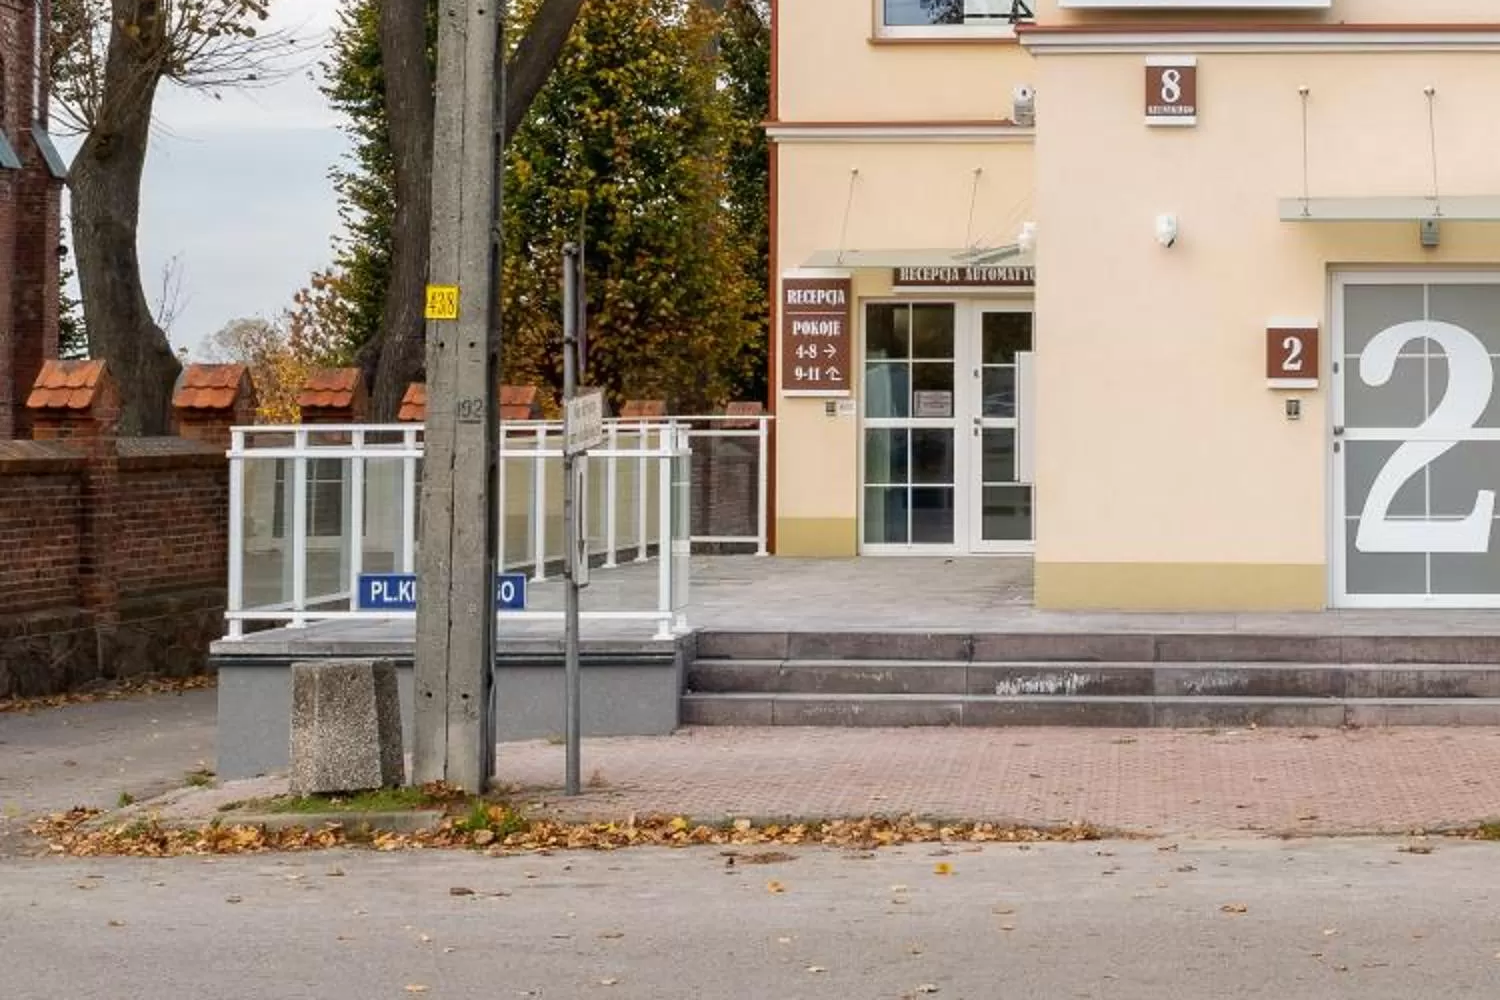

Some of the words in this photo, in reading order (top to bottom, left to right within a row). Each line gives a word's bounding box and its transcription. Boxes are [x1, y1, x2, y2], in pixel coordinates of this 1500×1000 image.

[1161, 69, 1181, 103] 8
[900, 267, 959, 284] RECEPCJA
[787, 289, 845, 305] RECEPCJA
[792, 321, 841, 336] POKOJE
[795, 343, 818, 359] 4-8
[1281, 336, 1303, 371] 2
[794, 366, 820, 381] 9-11
[1355, 319, 1496, 553] 2
